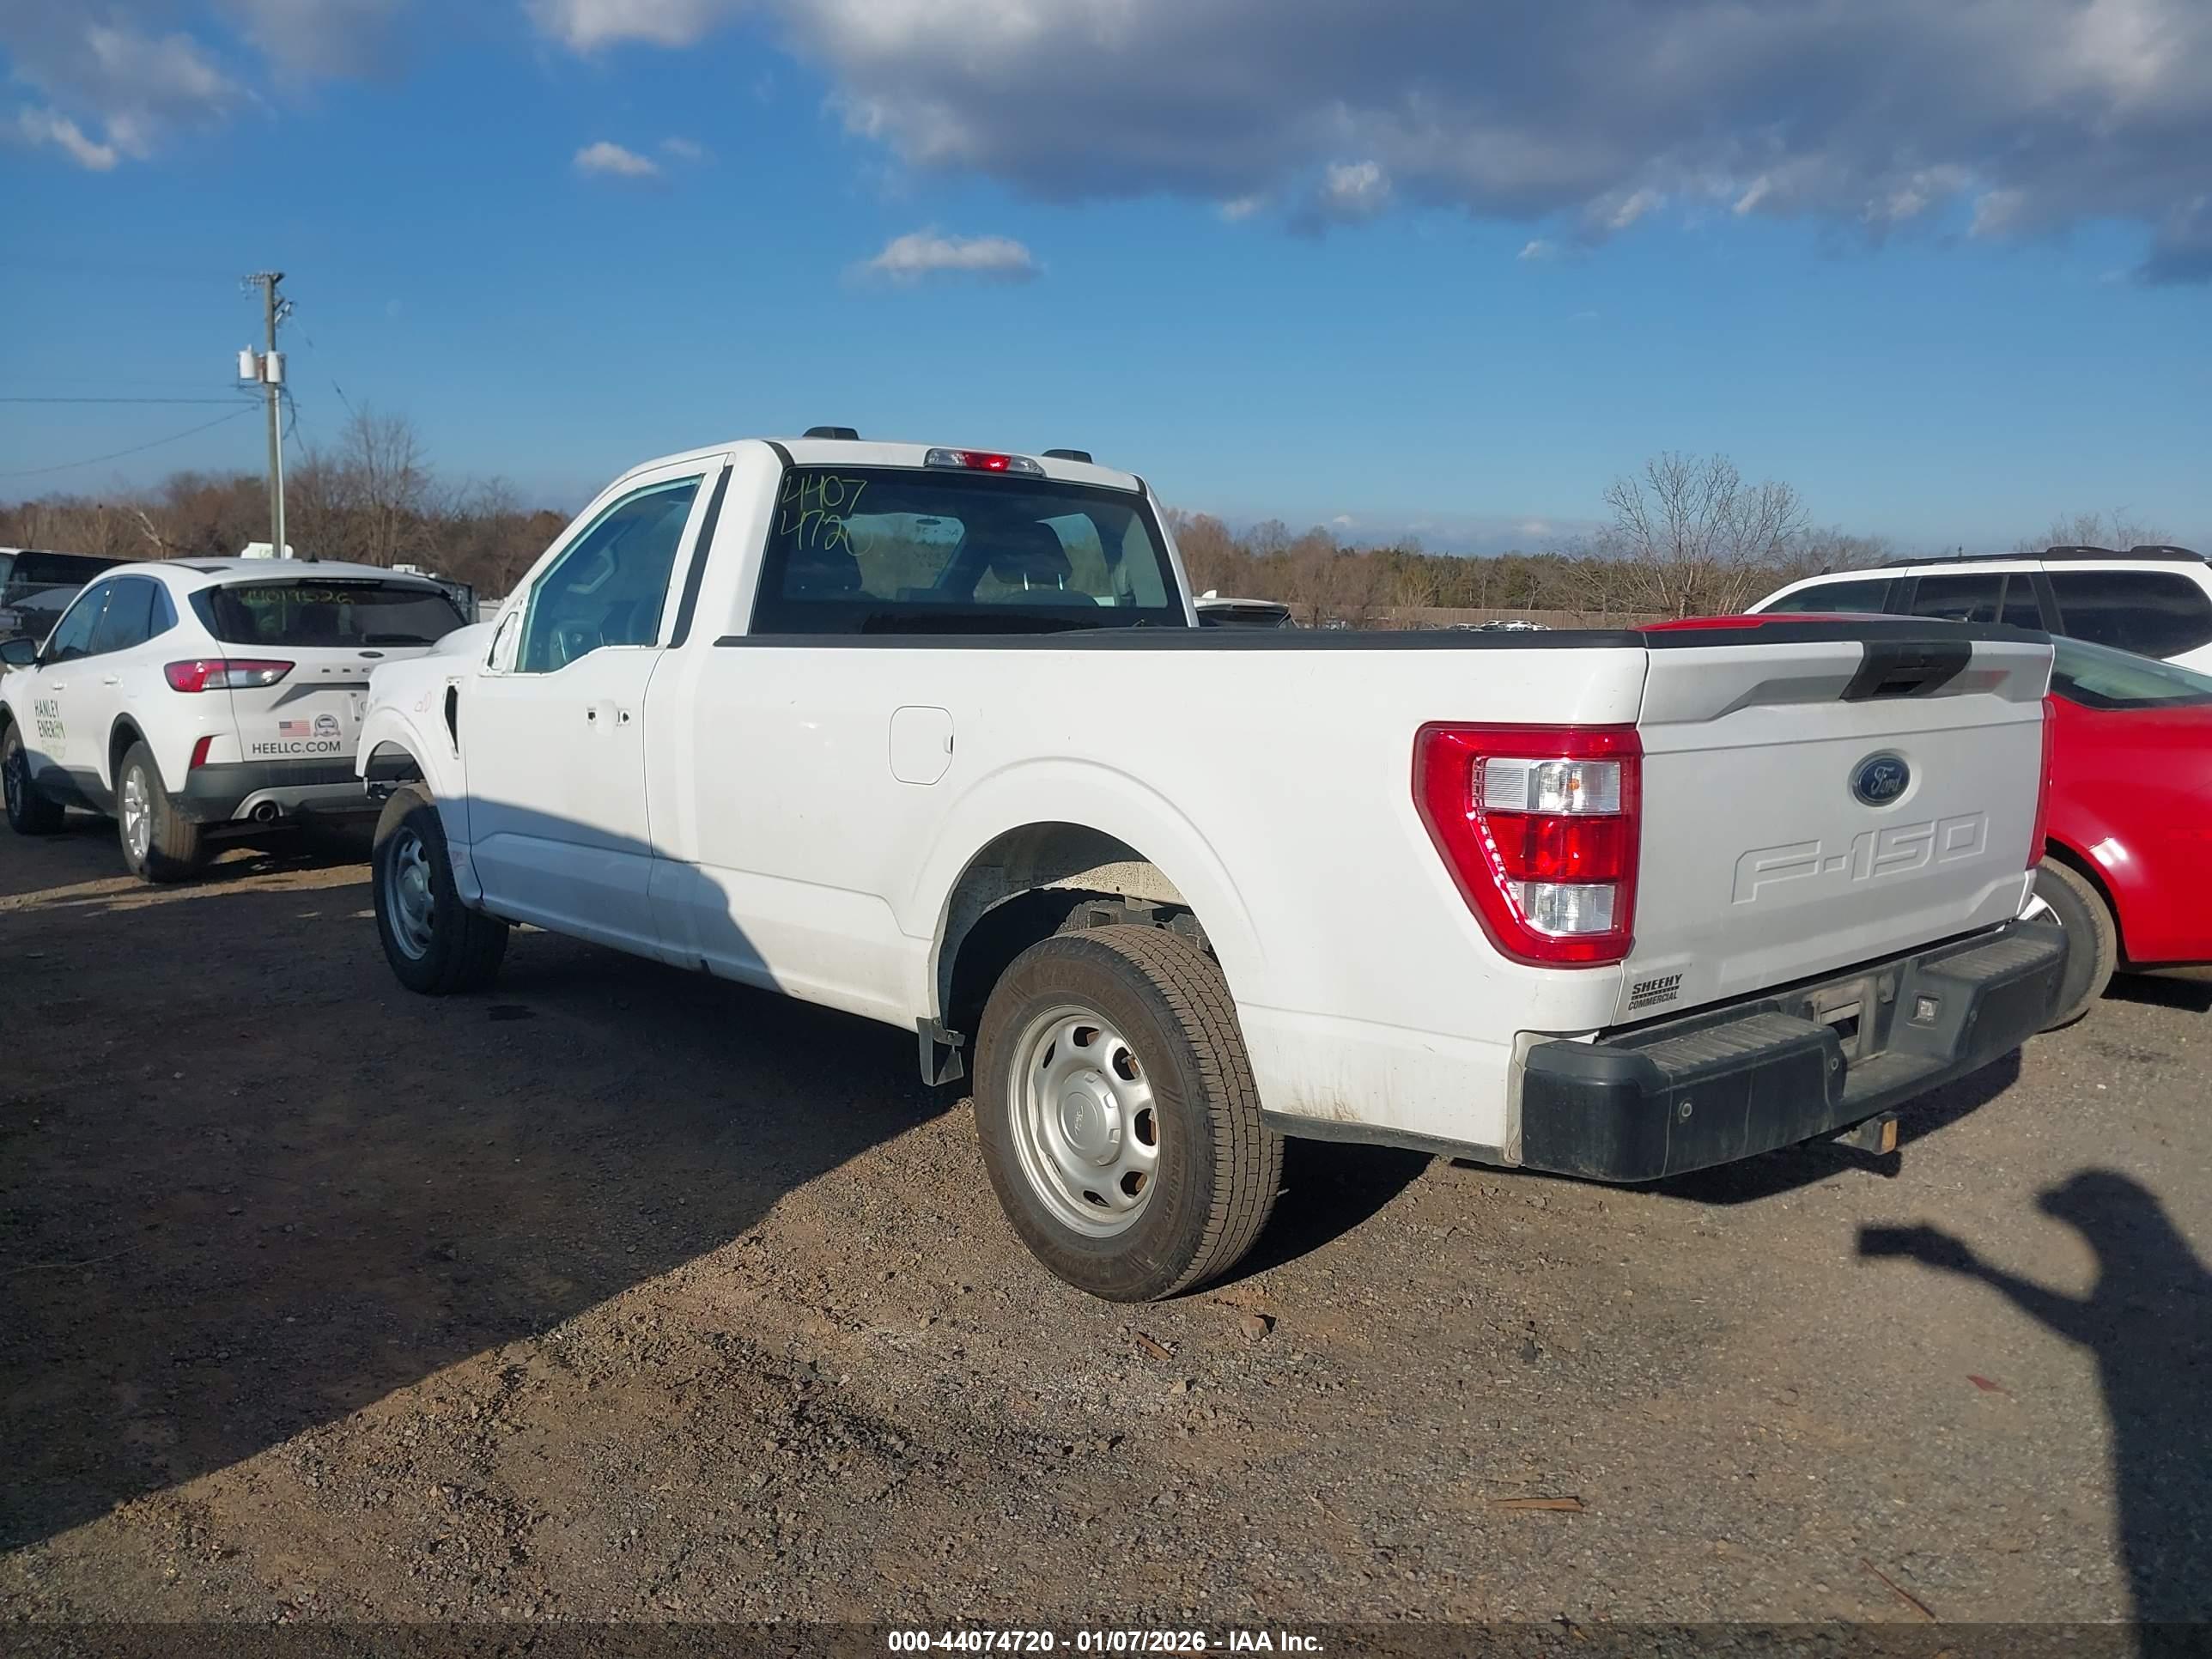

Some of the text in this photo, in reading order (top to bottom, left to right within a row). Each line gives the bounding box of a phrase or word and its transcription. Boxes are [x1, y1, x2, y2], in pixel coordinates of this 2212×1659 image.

[782, 474, 867, 514] 4407
[34, 699, 59, 718] HANLEY
[252, 741, 341, 754] HEELLC.COM
[1731, 811, 1990, 905] F-150
[1632, 974, 1683, 994] SHEEHY
[1628, 991, 1678, 1011] COMMERCIAL
